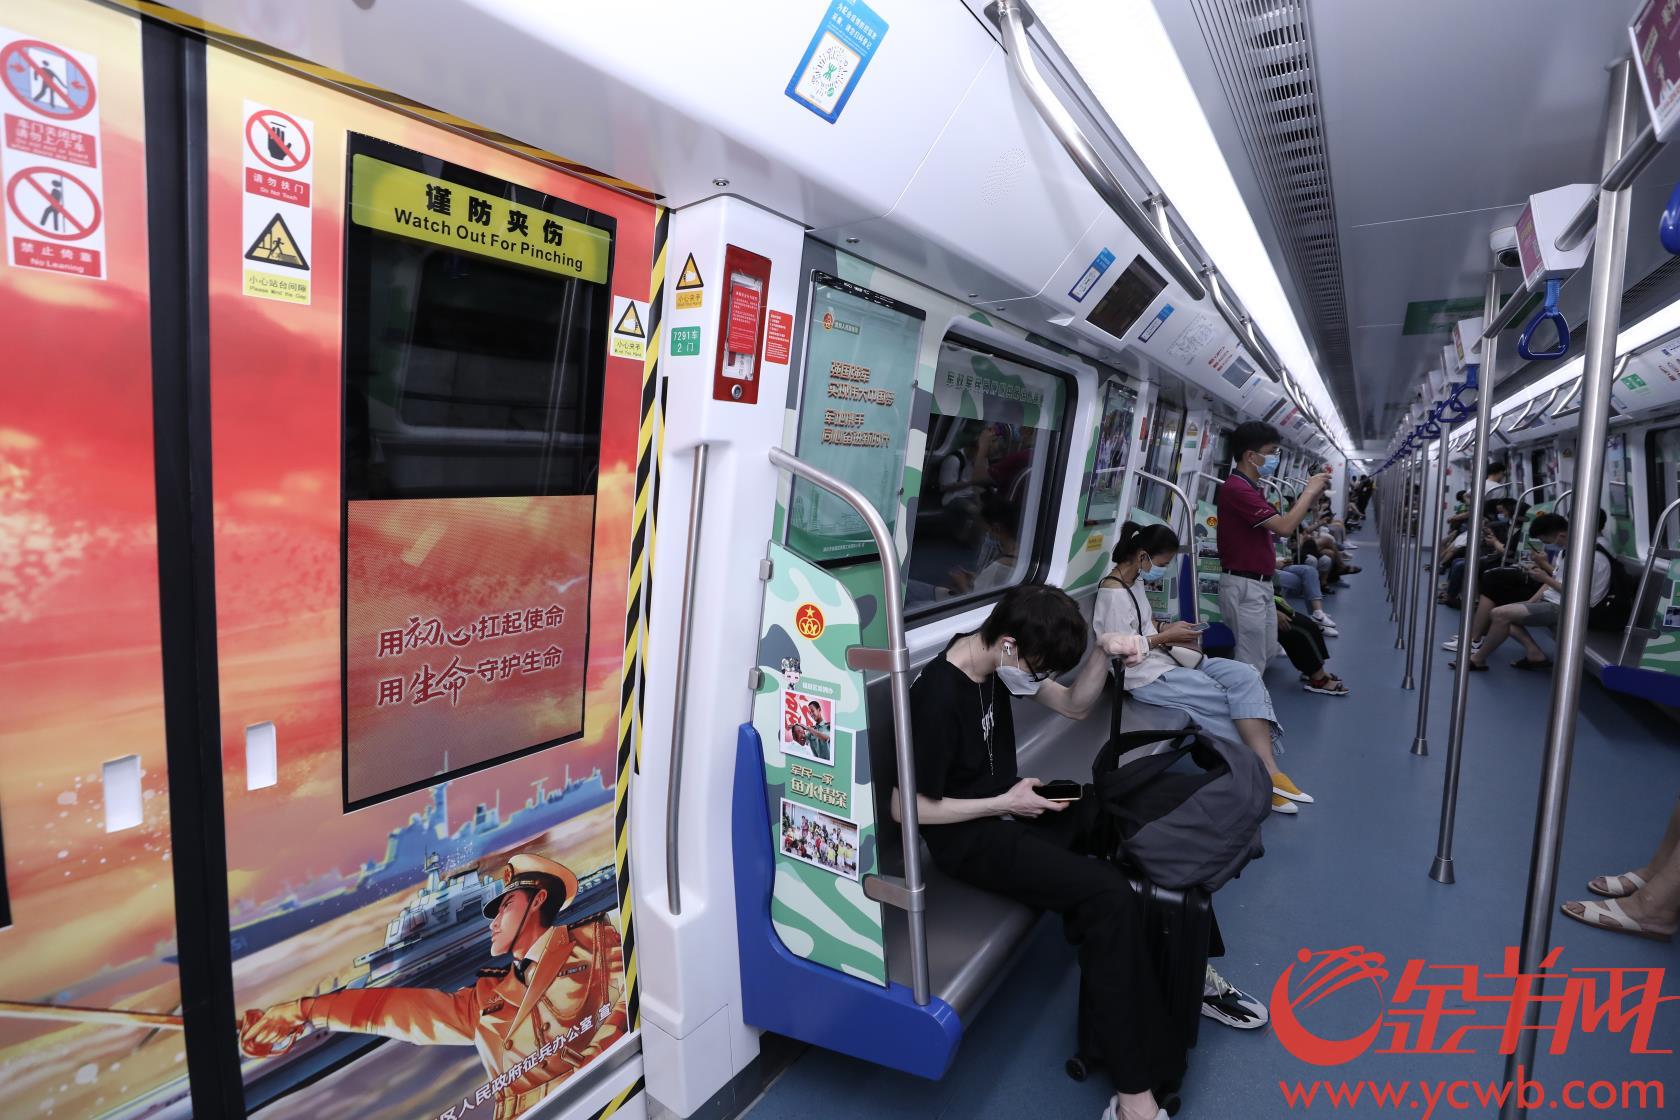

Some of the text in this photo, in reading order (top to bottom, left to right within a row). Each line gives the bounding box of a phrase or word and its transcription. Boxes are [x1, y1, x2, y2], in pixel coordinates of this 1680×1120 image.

[426, 183, 564, 247] 谨防夹伤
[394, 207, 583, 272] Watch Out For Pinching
[31, 258, 45, 266] No
[249, 275, 306, 292] 小心站台间隙
[673, 329, 699, 341] 7291车
[827, 382, 896, 407] 实现伟大中国梦
[377, 604, 565, 657] 用初心扛起使命
[377, 644, 563, 707] 用生命守护生命
[790, 763, 834, 785] 军民一家
[790, 778, 848, 809] 鱼水情深
